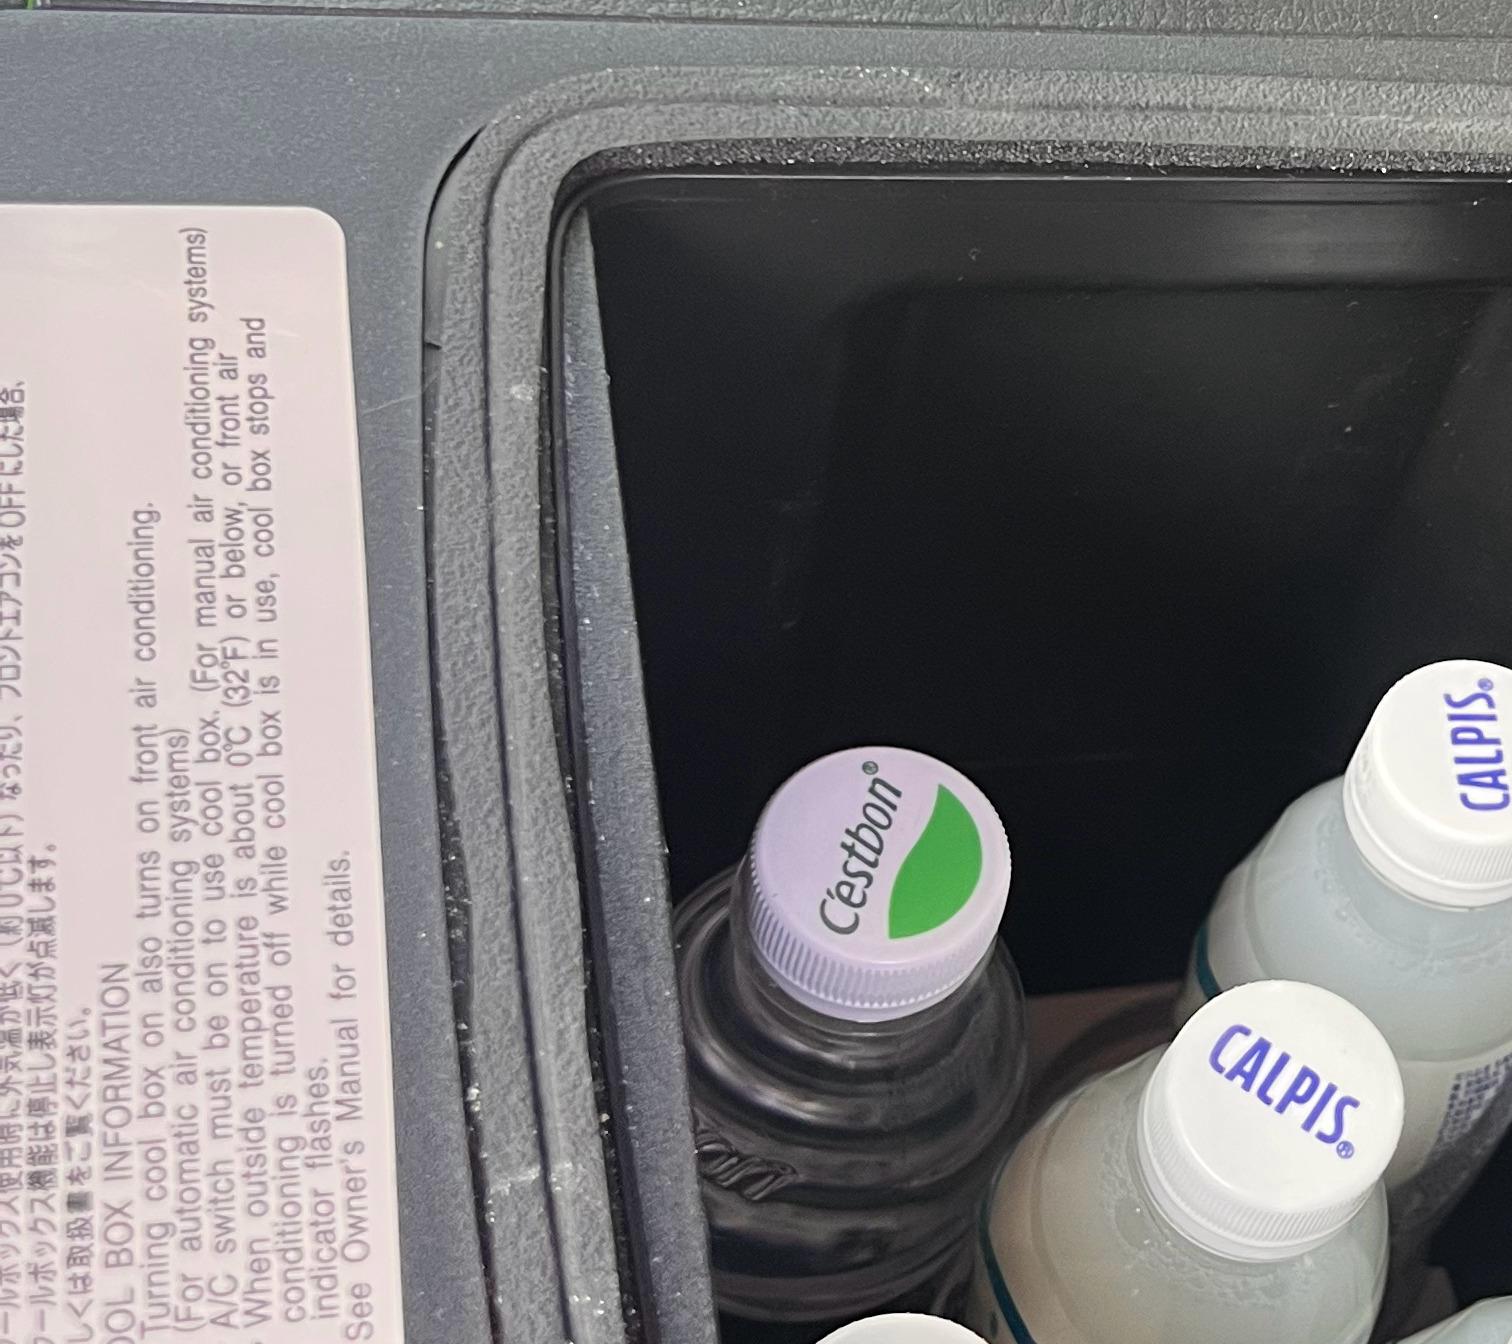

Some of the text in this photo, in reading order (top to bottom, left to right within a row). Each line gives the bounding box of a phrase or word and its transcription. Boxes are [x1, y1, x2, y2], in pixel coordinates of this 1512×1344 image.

[213, 351, 239, 382] air
[214, 391, 242, 448] front
[222, 460, 243, 487] or
[217, 497, 252, 584] below,
[227, 589, 248, 620] or
[180, 224, 238, 1331] A/C switch must be on to use cool box. (For manual air conditioning systems)
[227, 779, 256, 862] about
[240, 315, 311, 1324] conditioning is turned off while cool box is in use, cool box stops and
[128, 500, 176, 1332] Turning cool box on also turns on front air conditioning.
[230, 872, 257, 899] is
[161, 724, 210, 1333] (For automatic air conditioning systems)
[231, 912, 269, 1090] temperature
[99, 960, 132, 1182] INFORMATION
[323, 848, 373, 1341] See Owner's Manual for details.
[238, 1104, 268, 1221] outside
[302, 1055, 340, 1320] indicator flashes.
[104, 1196, 133, 1270] BOX
[242, 1235, 271, 1326] When
